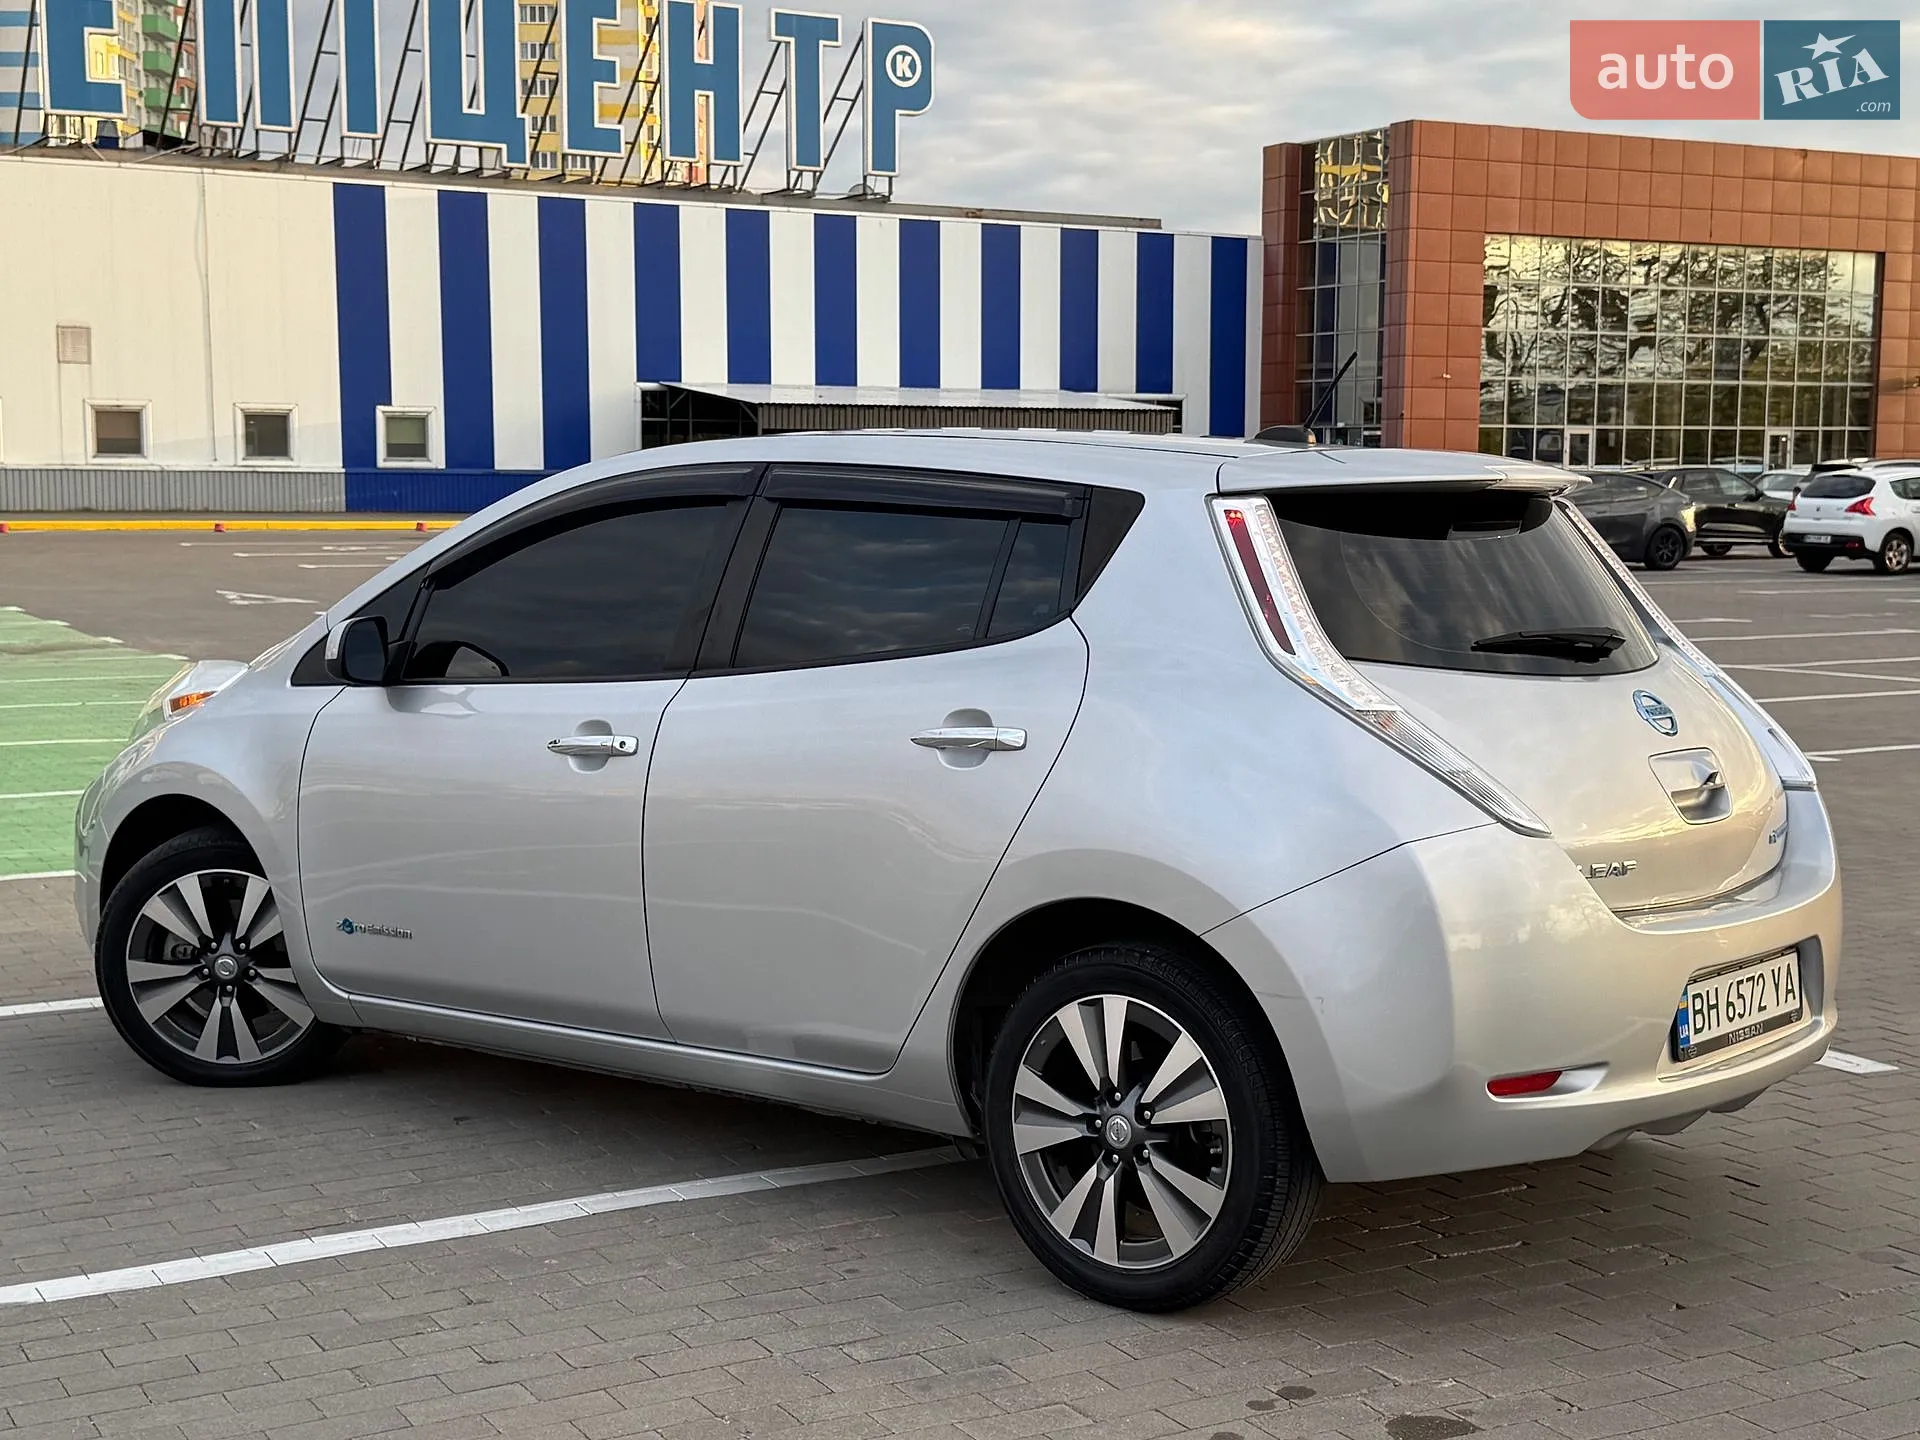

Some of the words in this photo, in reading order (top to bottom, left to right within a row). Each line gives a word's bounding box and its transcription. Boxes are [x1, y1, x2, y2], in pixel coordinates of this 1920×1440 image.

[1692, 986, 1720, 1035] BH
[1726, 972, 1767, 1023] 6572
[1771, 963, 1796, 1007] YA
[1728, 1024, 1764, 1044] NISSAN
